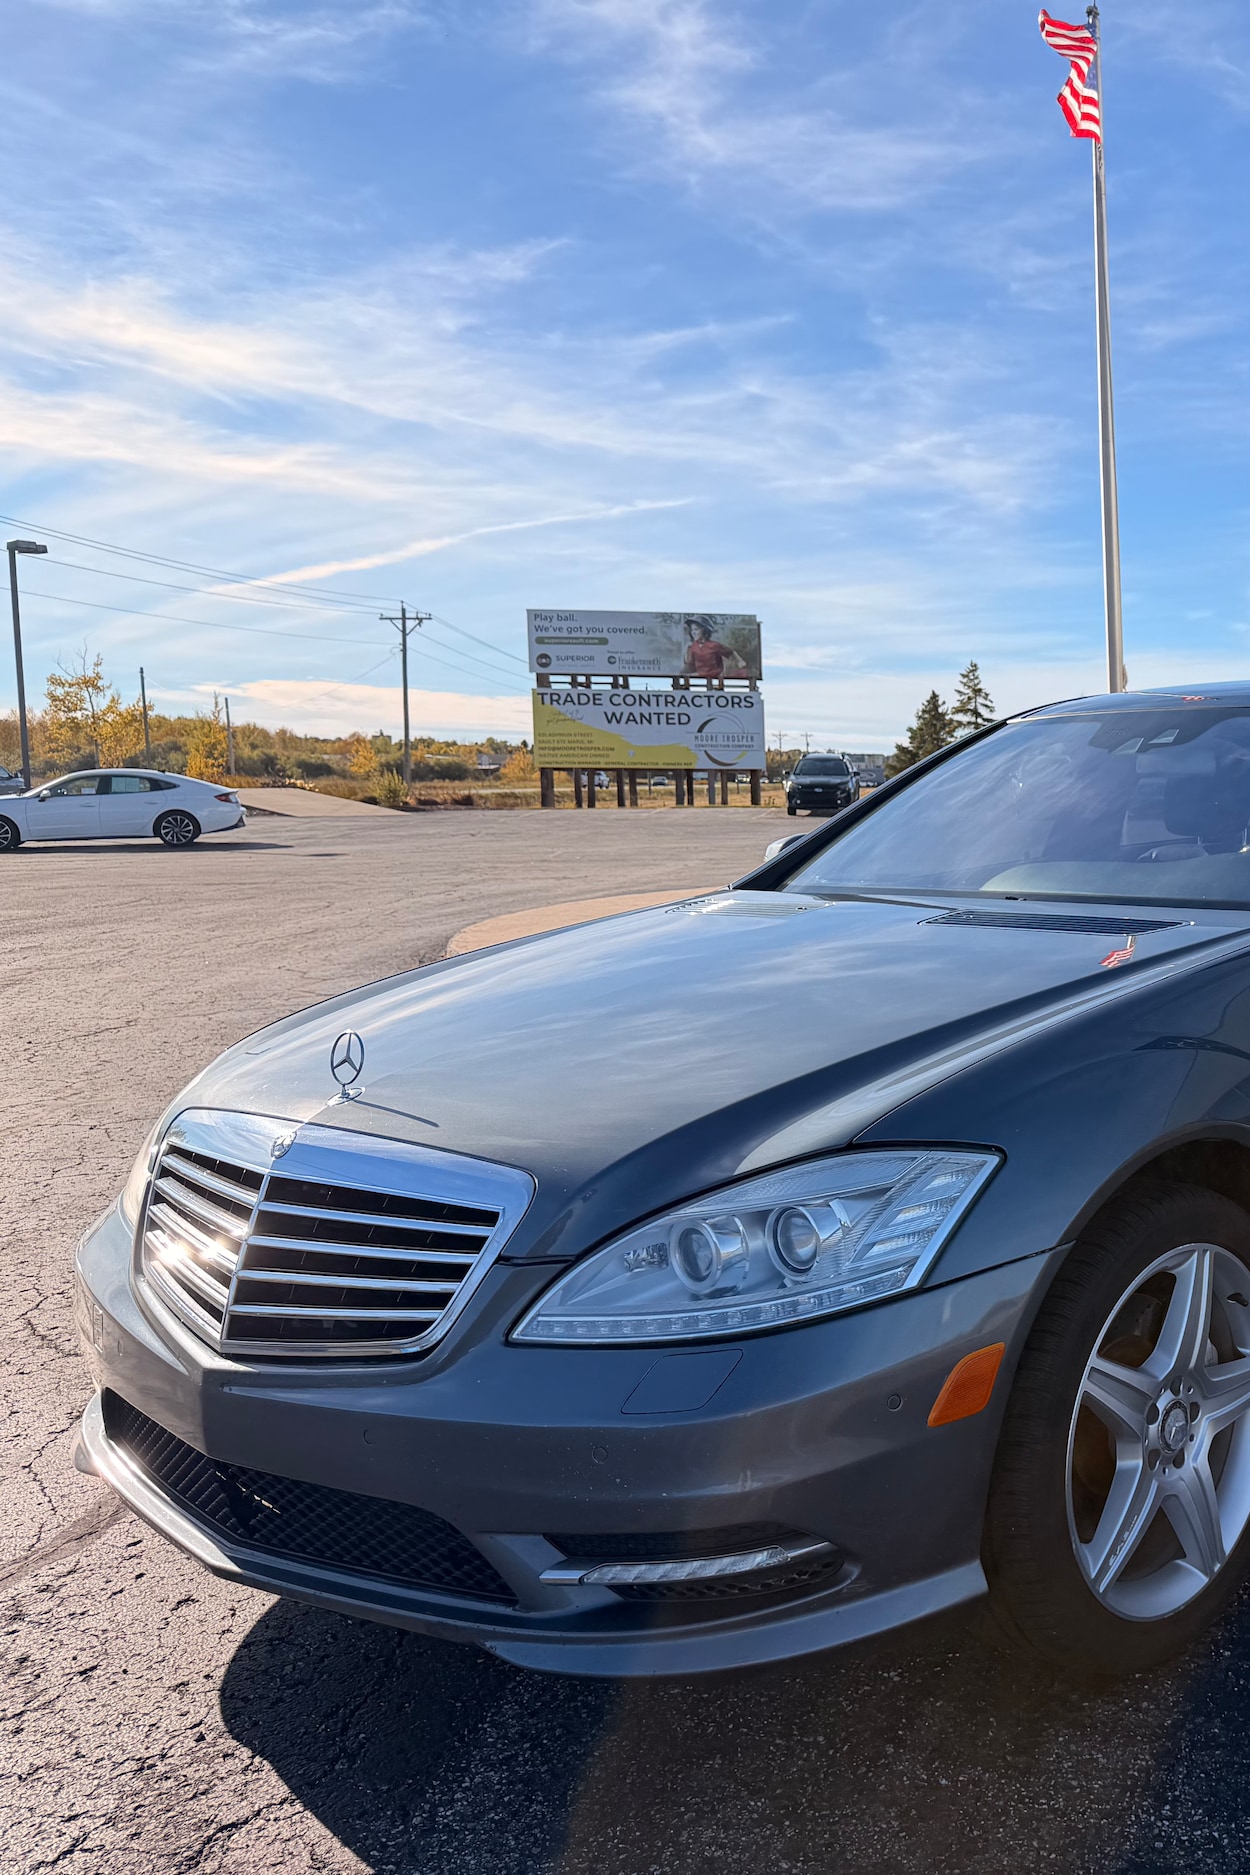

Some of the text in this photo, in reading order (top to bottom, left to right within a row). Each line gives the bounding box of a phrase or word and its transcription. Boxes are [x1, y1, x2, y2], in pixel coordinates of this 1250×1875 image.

[534, 613, 578, 623] Play ball.
[534, 624, 649, 635] We've got you covered.
[536, 692, 754, 709] TRADE CONTRACTORS
[603, 711, 691, 726] WANTED
[694, 735, 755, 743] MOORE TROSPER
